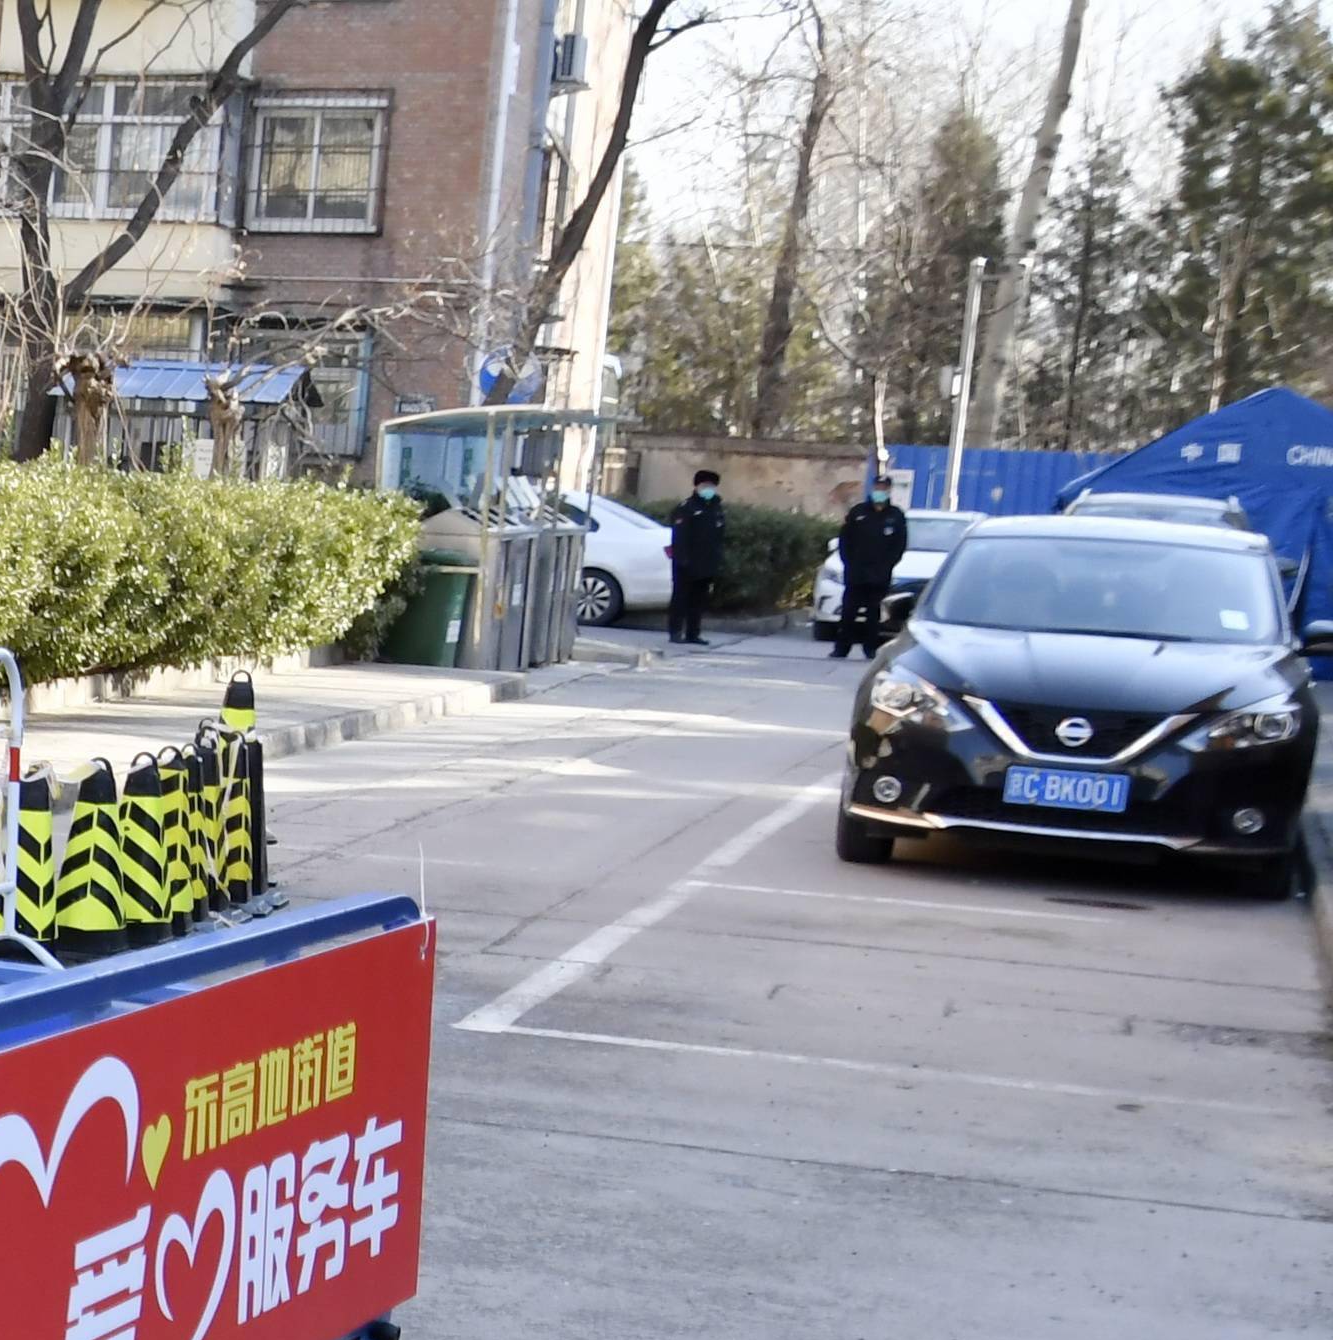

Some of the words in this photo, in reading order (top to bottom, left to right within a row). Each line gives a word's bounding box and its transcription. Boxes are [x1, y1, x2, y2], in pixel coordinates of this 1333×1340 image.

[182, 1021, 358, 1161] 东高地街道
[236, 1115, 404, 1326] 服务车
